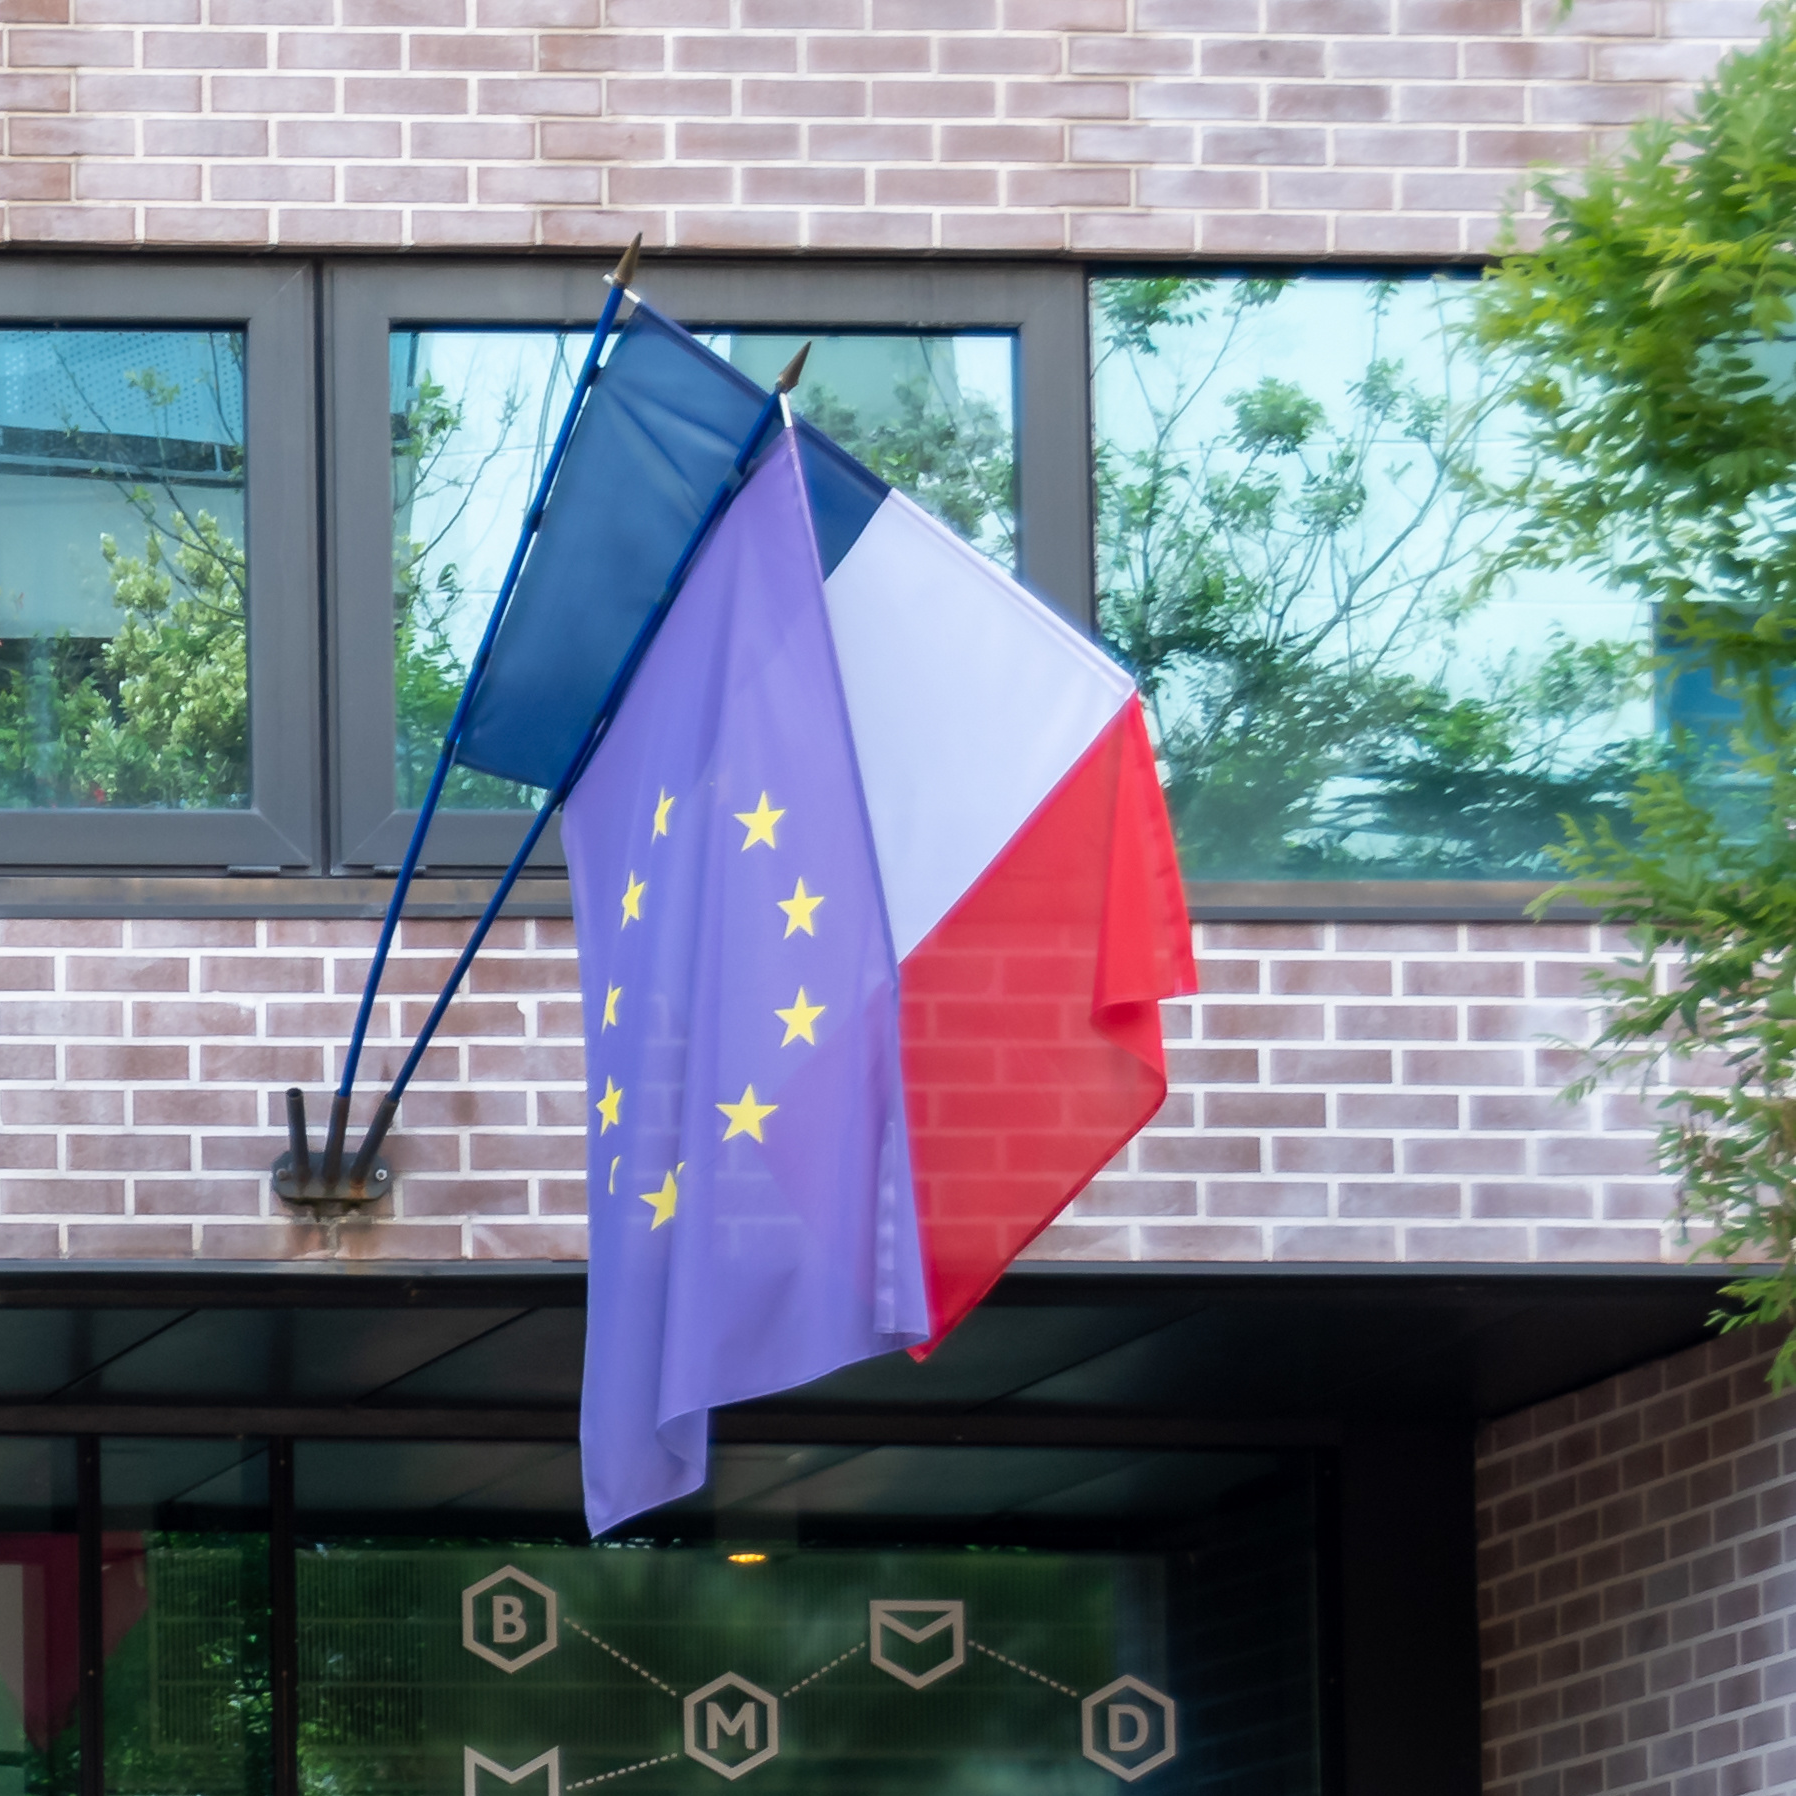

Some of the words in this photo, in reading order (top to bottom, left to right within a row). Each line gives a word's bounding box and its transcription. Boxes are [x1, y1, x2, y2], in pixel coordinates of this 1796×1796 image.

[492, 1594, 527, 1645] B
[705, 1701, 758, 1752] M
[1106, 1702, 1151, 1752] D
